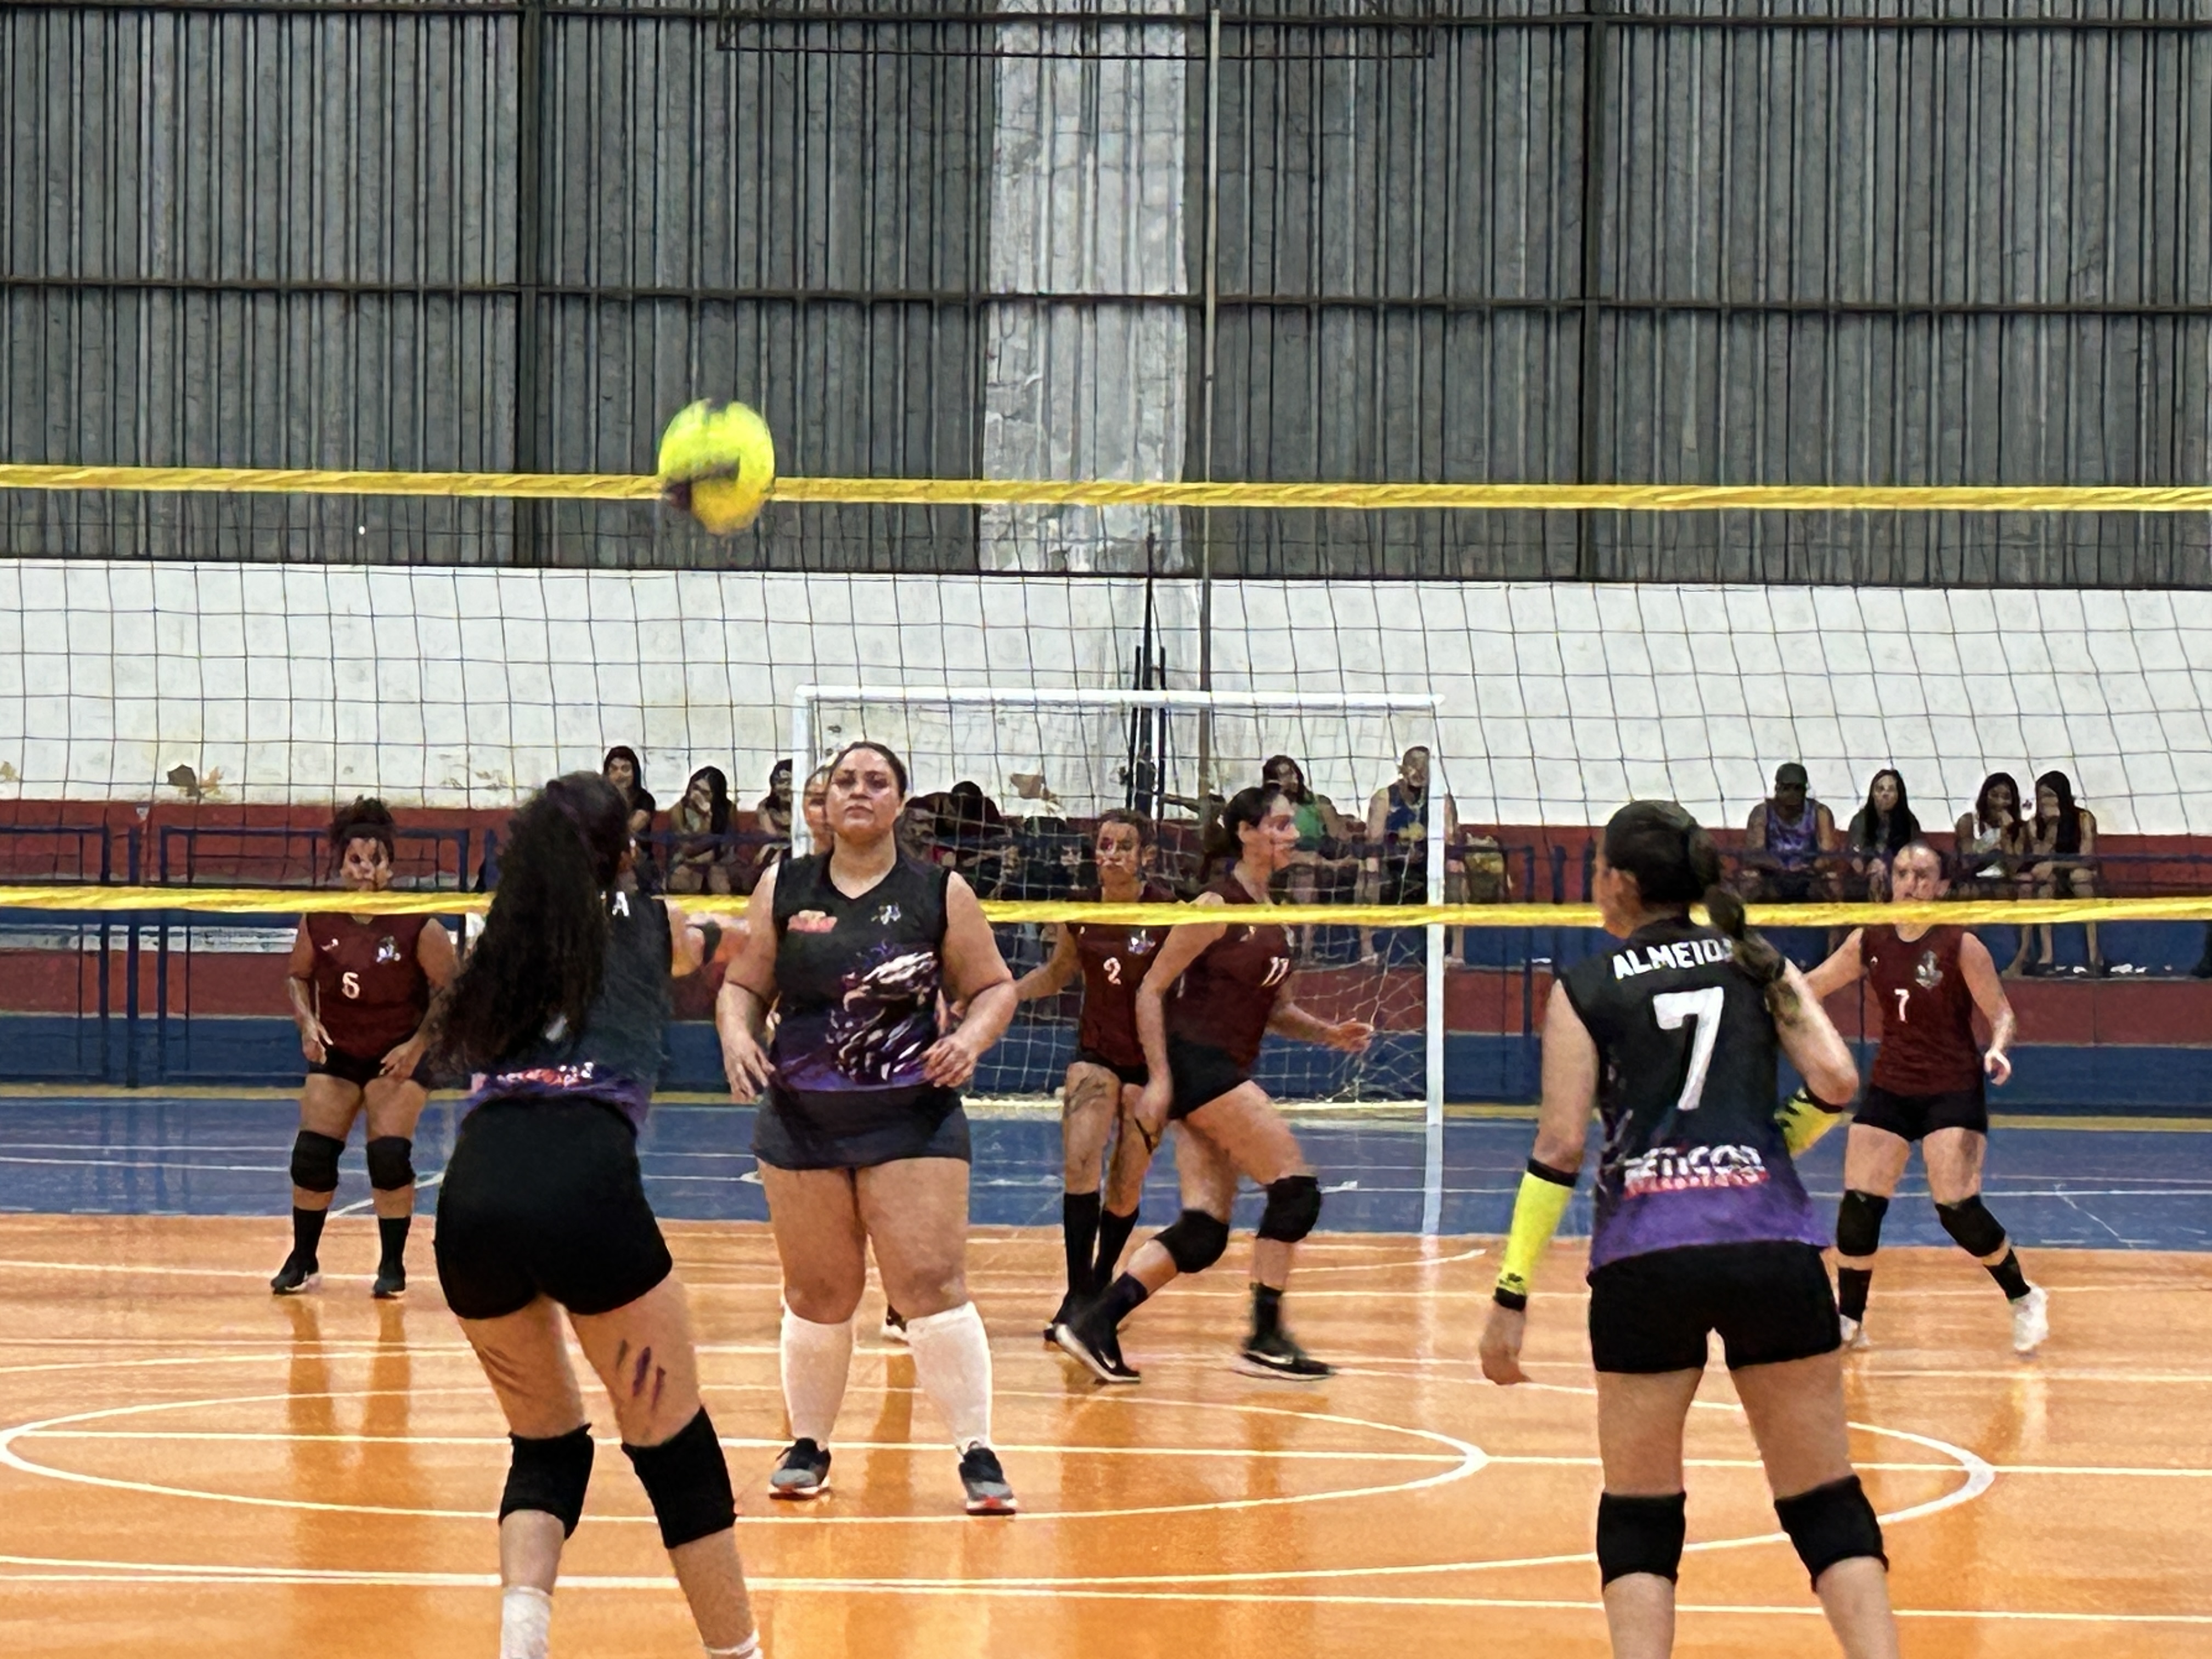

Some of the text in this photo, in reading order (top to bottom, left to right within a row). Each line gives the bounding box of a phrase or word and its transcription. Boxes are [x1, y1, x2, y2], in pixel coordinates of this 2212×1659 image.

[1103, 957, 1121, 985] 2
[1894, 989, 1910, 1023] 7
[1653, 986, 1724, 1110] 7
